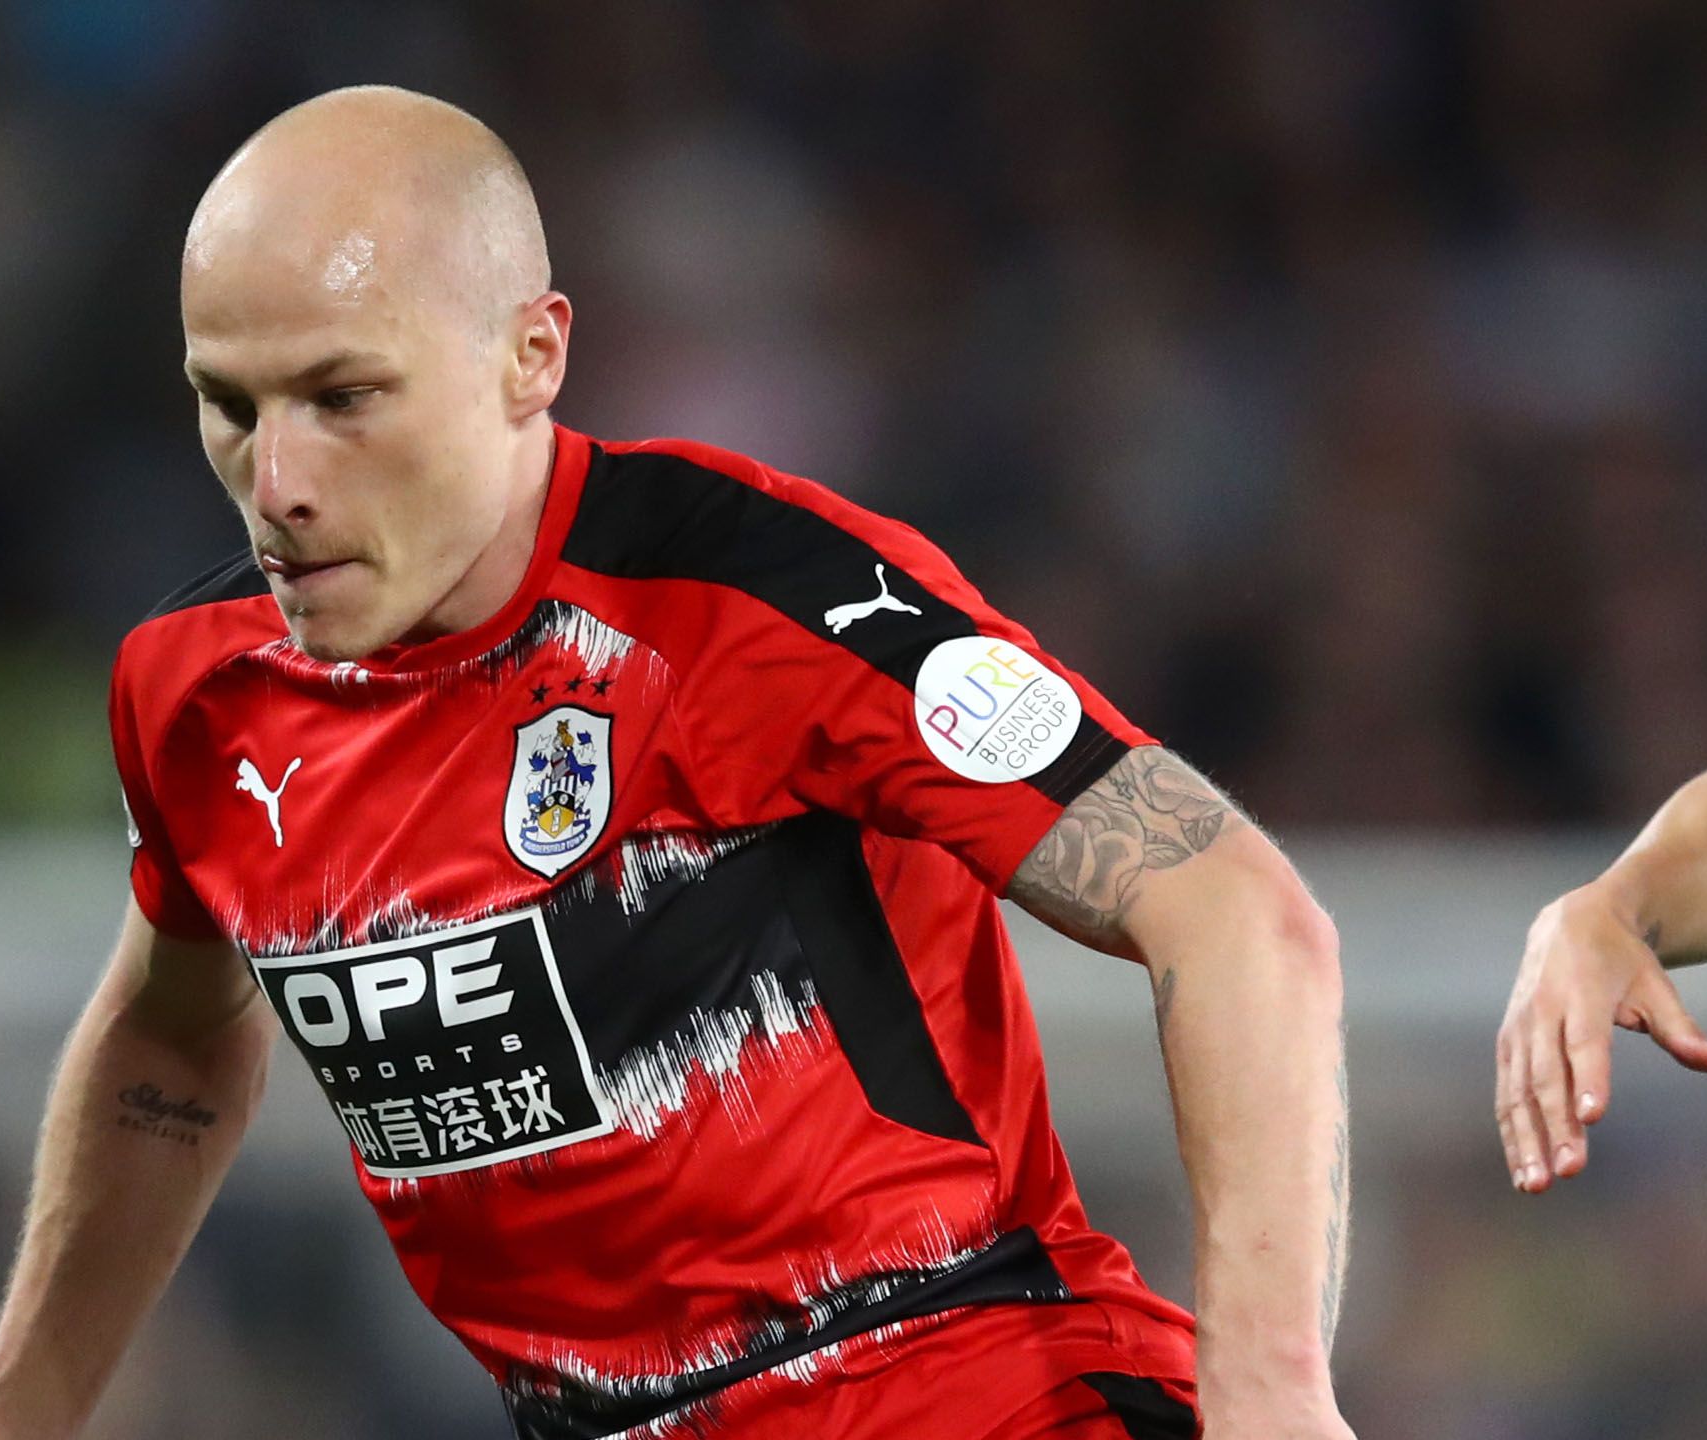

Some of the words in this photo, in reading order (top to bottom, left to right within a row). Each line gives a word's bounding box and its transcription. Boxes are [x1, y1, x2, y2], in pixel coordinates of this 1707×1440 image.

[925, 646, 1035, 751] PURE
[979, 683, 1059, 765] BUSINESS
[1006, 700, 1068, 769] GROUP
[283, 936, 515, 1047] OPE
[319, 1033, 523, 1084] SPORTS
[335, 1065, 566, 1161] 体育滚球
